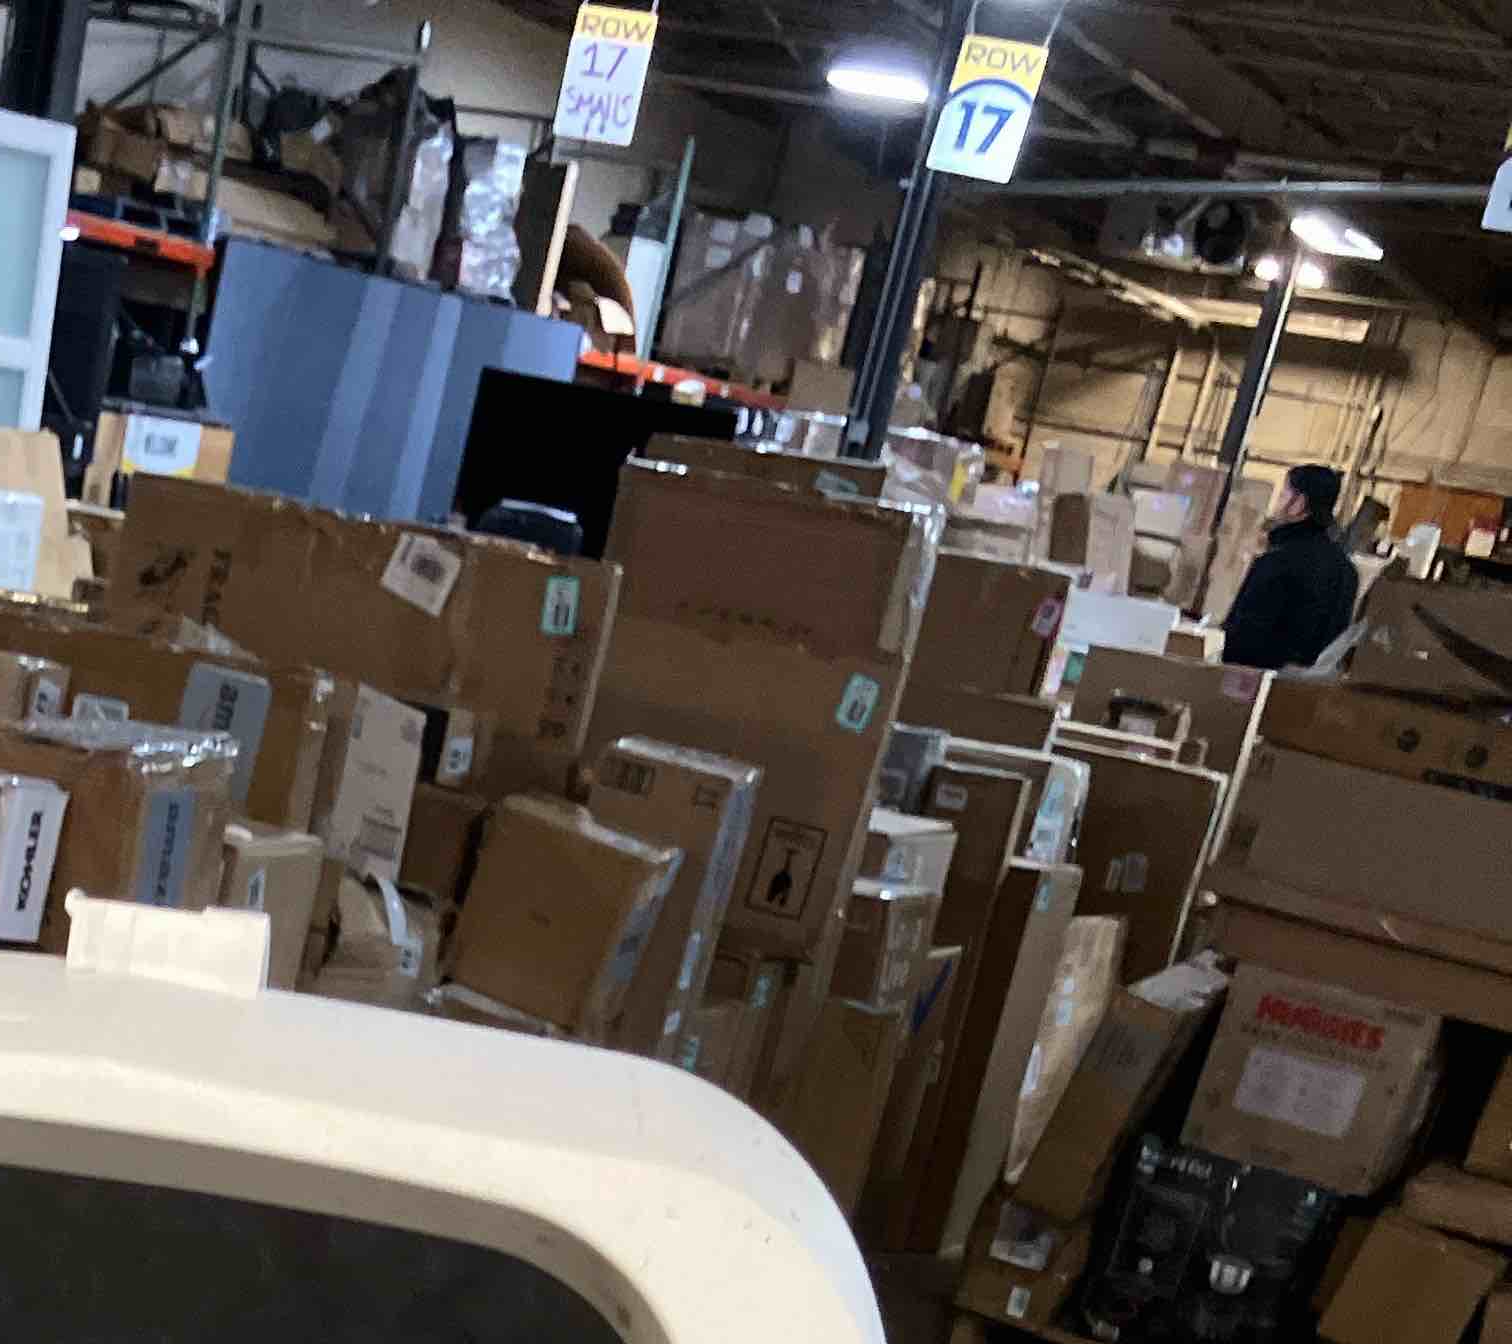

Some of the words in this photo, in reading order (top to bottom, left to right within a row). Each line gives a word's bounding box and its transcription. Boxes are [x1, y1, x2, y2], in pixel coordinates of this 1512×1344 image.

[581, 15, 652, 41] ROW
[580, 41, 628, 81] 17
[964, 42, 1041, 76] ROW
[953, 100, 1015, 154] 17
